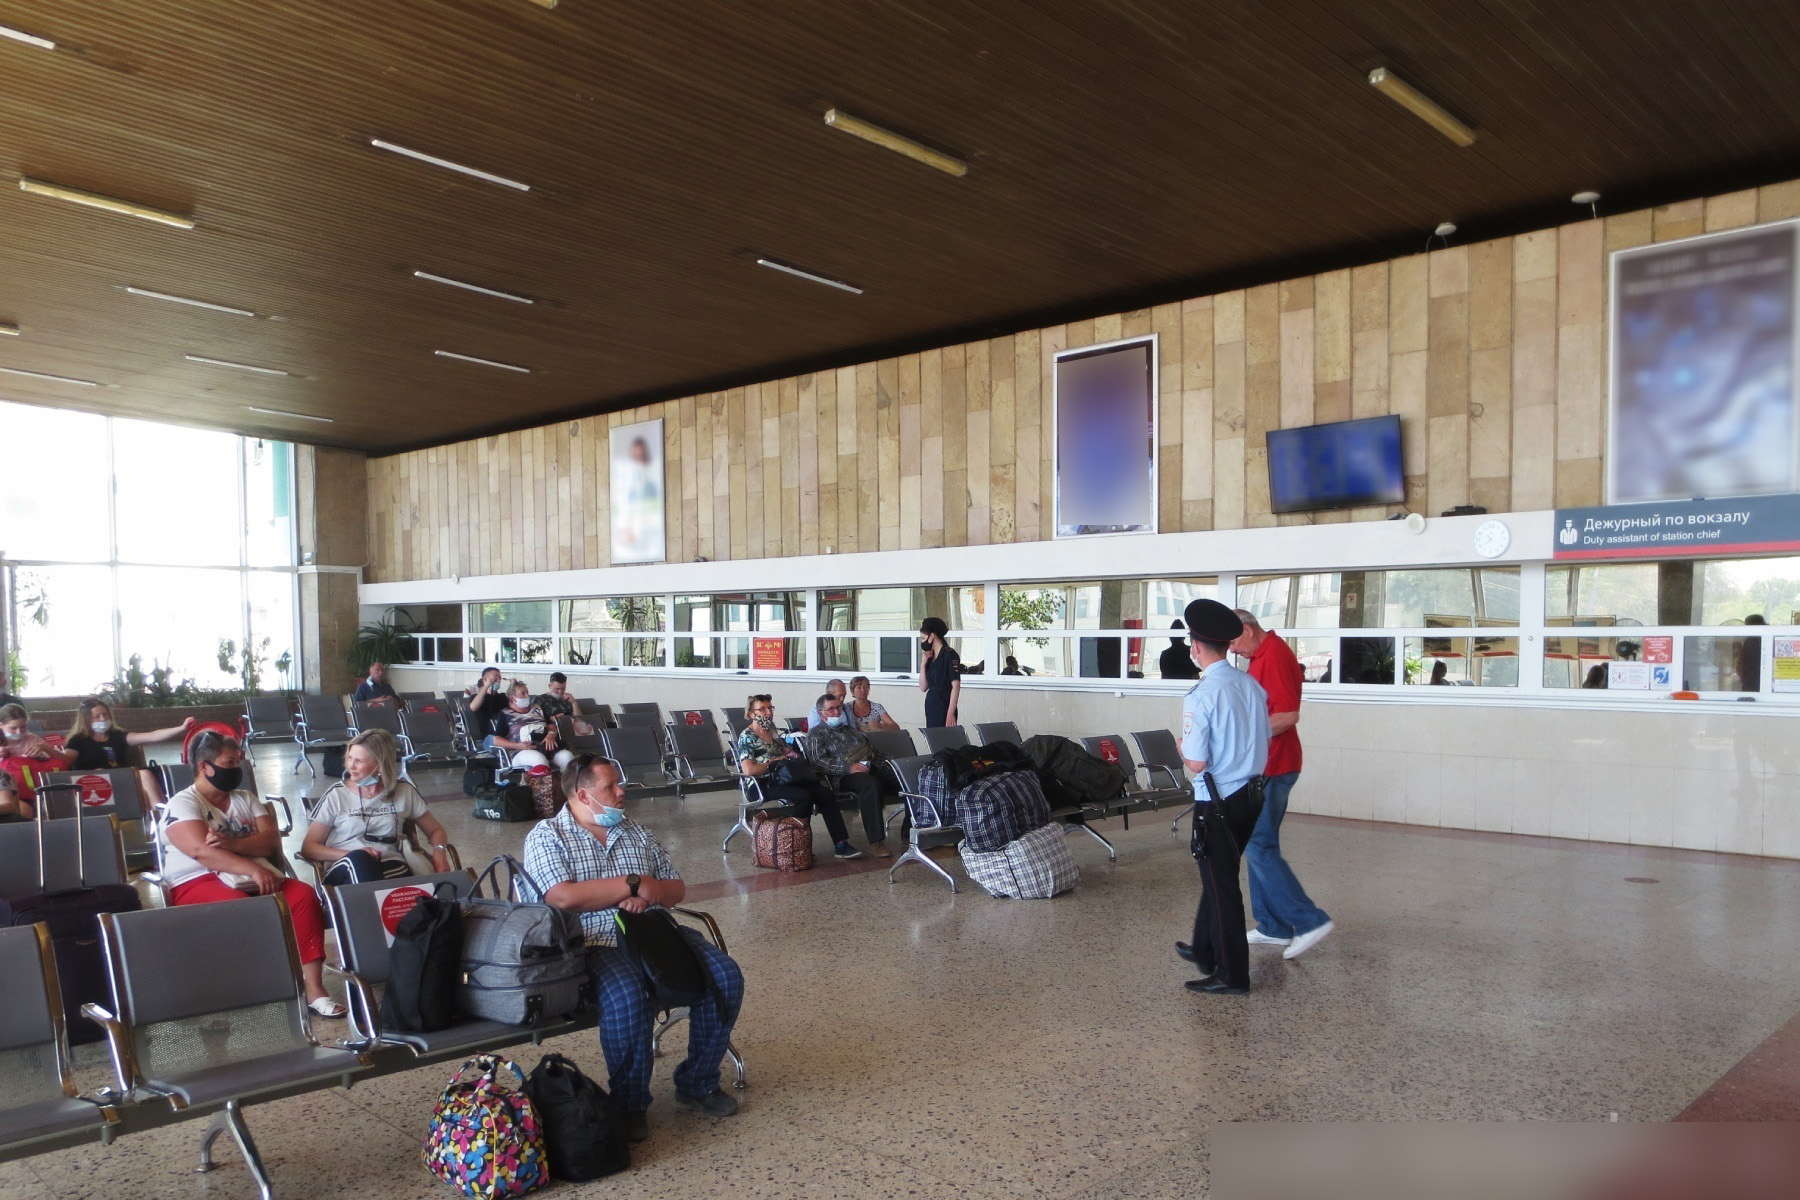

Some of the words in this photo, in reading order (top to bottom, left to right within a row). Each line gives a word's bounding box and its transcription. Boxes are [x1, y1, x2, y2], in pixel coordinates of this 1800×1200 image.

[1584, 514, 1661, 532] Дежурный
[1665, 515, 1684, 526] по
[1688, 511, 1751, 525] вокзалу
[1583, 535, 1605, 546] Duty
[1606, 533, 1648, 544] assistant
[1650, 532, 1660, 541] of
[1662, 531, 1694, 541] station
[1696, 529, 1721, 539] chief
